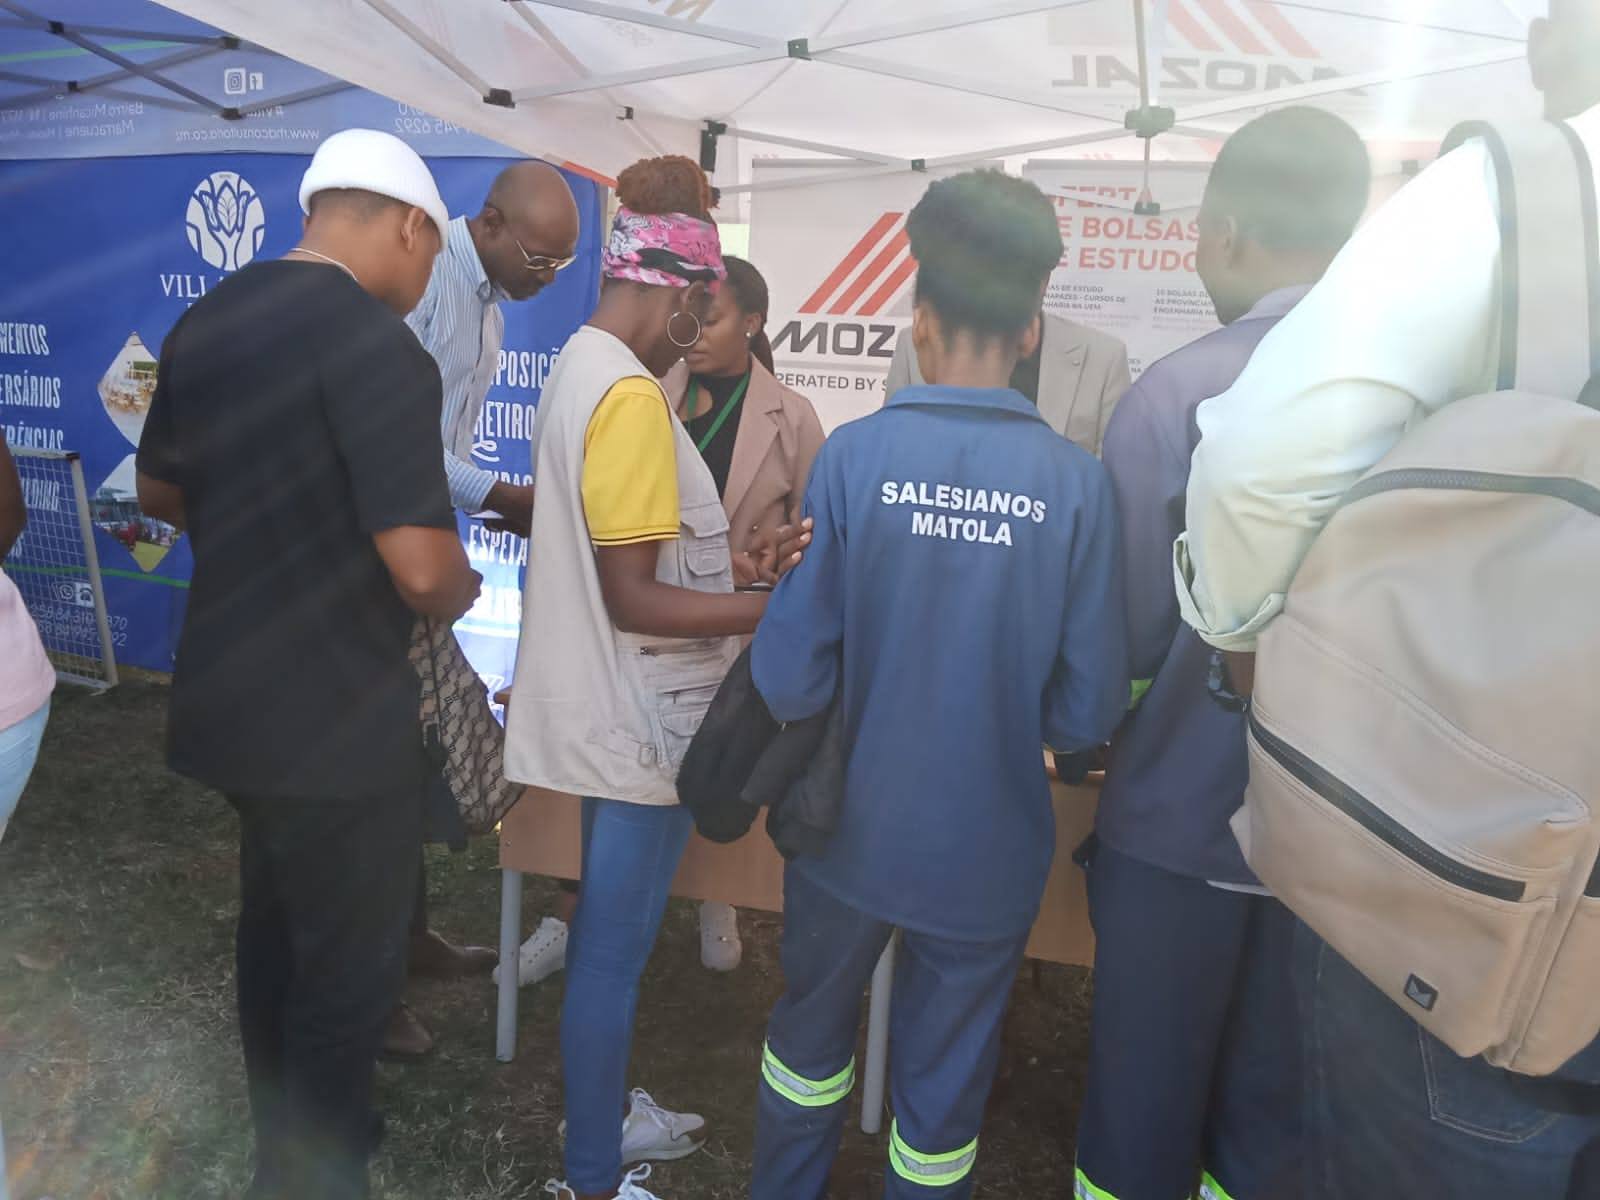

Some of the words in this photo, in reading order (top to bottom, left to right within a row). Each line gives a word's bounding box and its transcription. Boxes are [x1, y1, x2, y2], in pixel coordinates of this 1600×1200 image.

[159, 273, 225, 298] VILL
[770, 320, 896, 358] MOZ
[855, 377, 877, 391] BY
[881, 481, 1046, 523] SALESIANOS
[911, 511, 1013, 546] MATOLA
